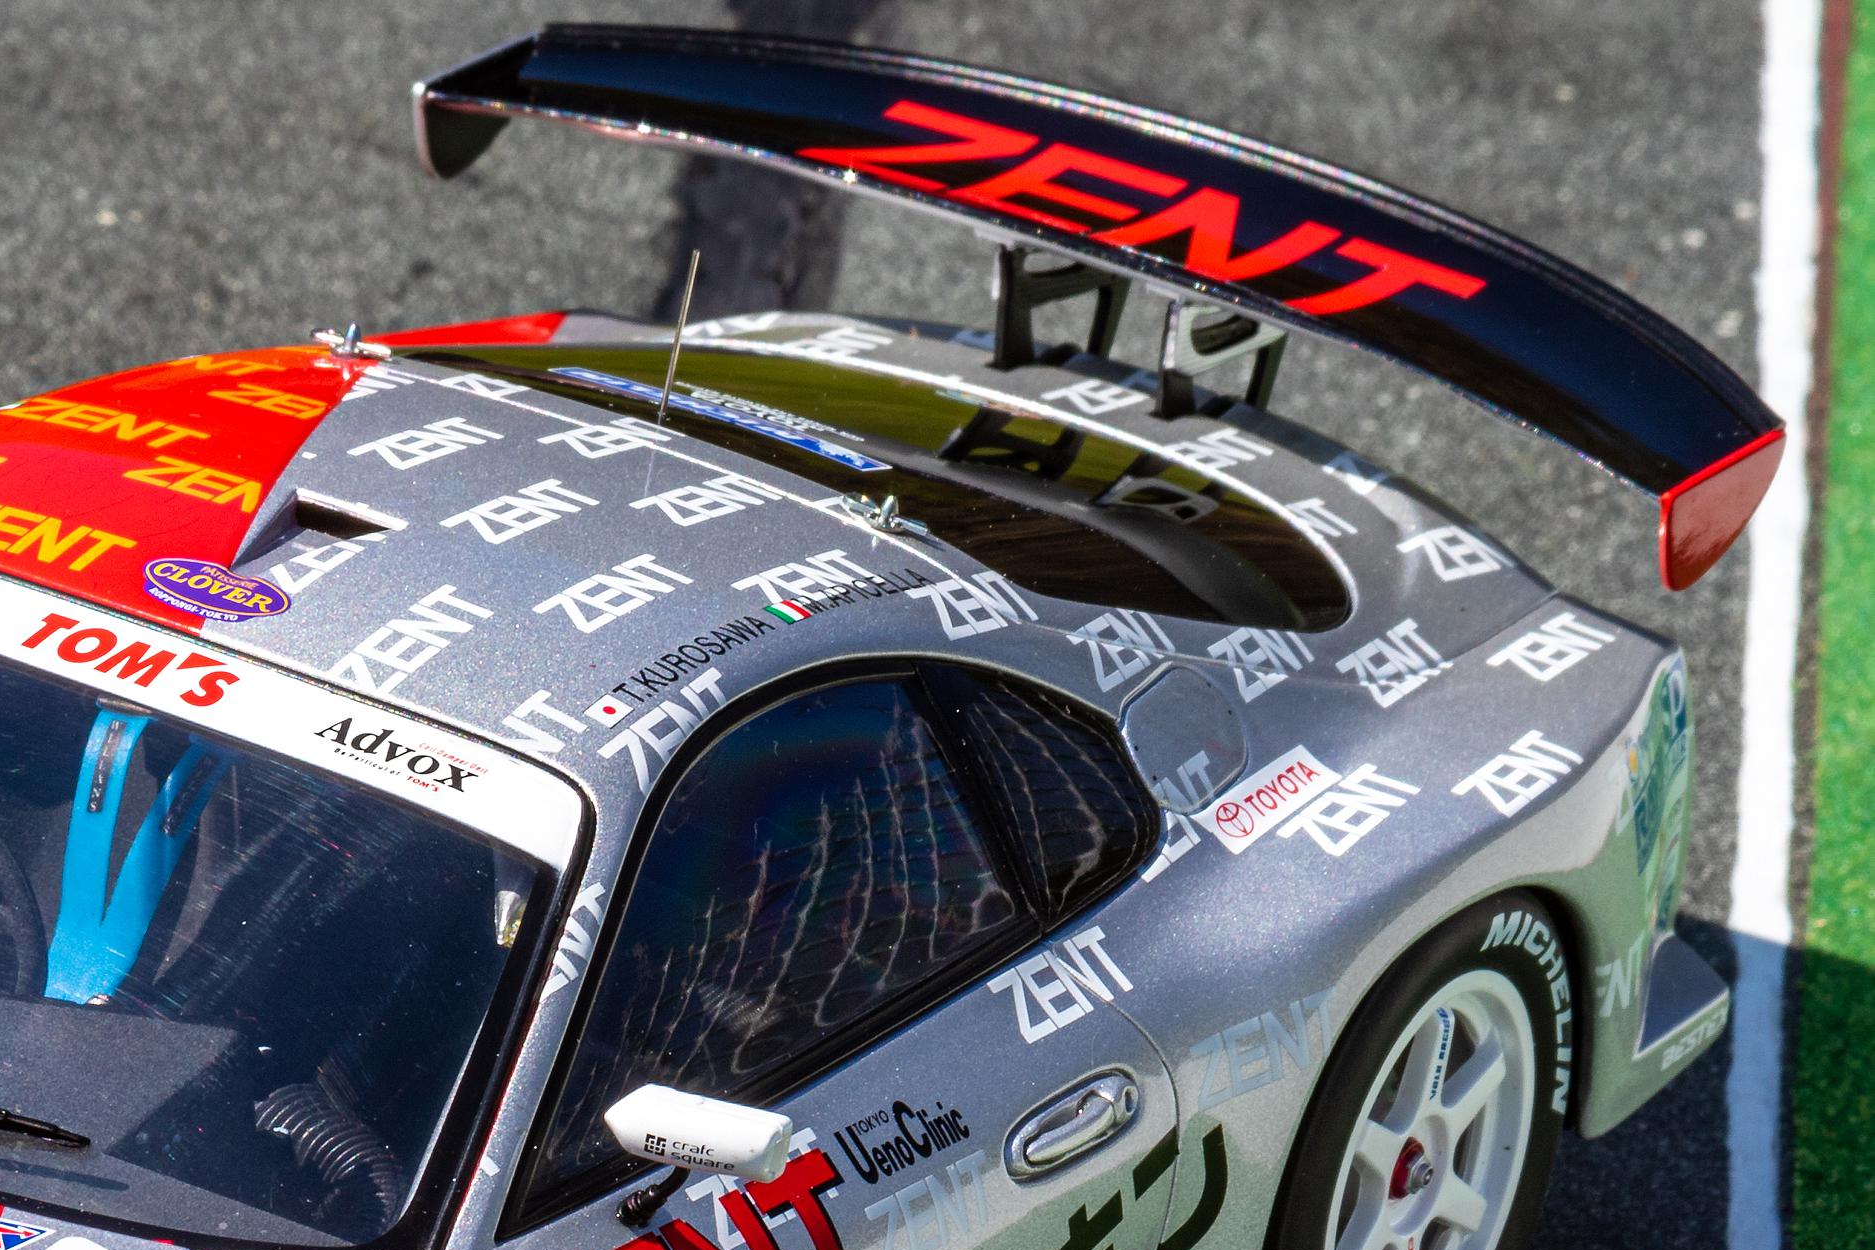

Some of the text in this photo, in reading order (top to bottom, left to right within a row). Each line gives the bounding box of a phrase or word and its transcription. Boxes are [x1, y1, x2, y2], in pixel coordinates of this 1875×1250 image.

[795, 101, 1486, 314] ZENT
[2, 398, 209, 448] ZENT
[207, 383, 328, 420] ZE
[346, 416, 505, 471] ZENT
[123, 456, 263, 514] ZEN
[438, 478, 601, 545] ZENT
[629, 473, 786, 527] ZENT
[153, 562, 274, 613] CLOVER
[532, 553, 695, 634] ZENT
[730, 549, 887, 604] ZENT
[911, 570, 1040, 641] ZENT
[21, 612, 241, 708] TOM'S
[326, 583, 495, 695] ZENT
[611, 614, 776, 704] T.KUROSAWA
[1066, 608, 1176, 693] ZENT
[1207, 626, 1316, 703] ZENT
[1336, 618, 1454, 709] ZENT
[1486, 612, 1616, 681] ZENT
[313, 717, 479, 793] Advox
[506, 689, 592, 760] NT
[596, 667, 729, 797] ZENT
[1244, 759, 1321, 818] TOYOTA
[1276, 763, 1421, 856] ZENT
[1451, 729, 1584, 818] ZENT
[987, 925, 1134, 1045] ZENT
[1480, 910, 1574, 1115] MICHELIN
[1189, 986, 1338, 1113] ZENT
[670, 1151, 736, 1171] square
[852, 1110, 890, 1136] TOKYO
